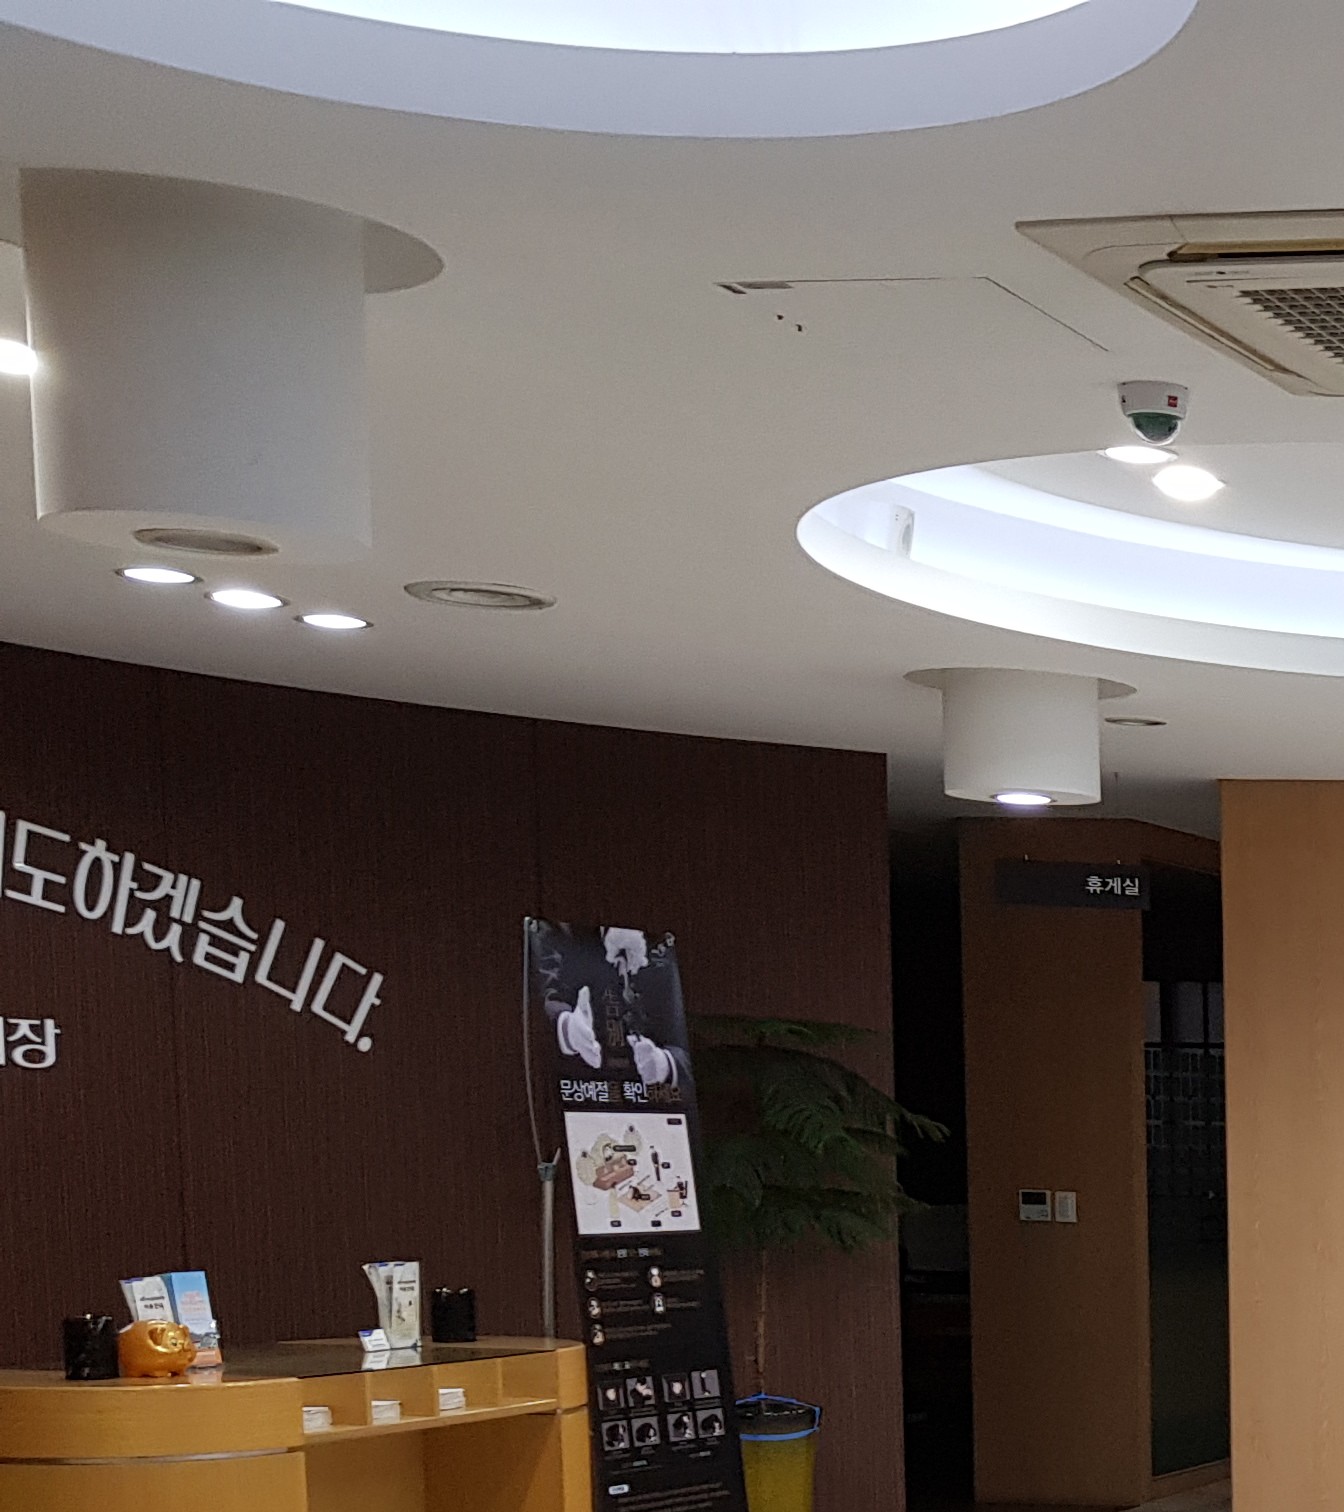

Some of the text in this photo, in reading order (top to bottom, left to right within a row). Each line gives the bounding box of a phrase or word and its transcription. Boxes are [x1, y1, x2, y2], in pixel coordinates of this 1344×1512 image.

[1085, 875, 1140, 897] 휴게실
[0, 809, 383, 1053] 도하겠습니다.
[0, 1016, 60, 1070] 장
